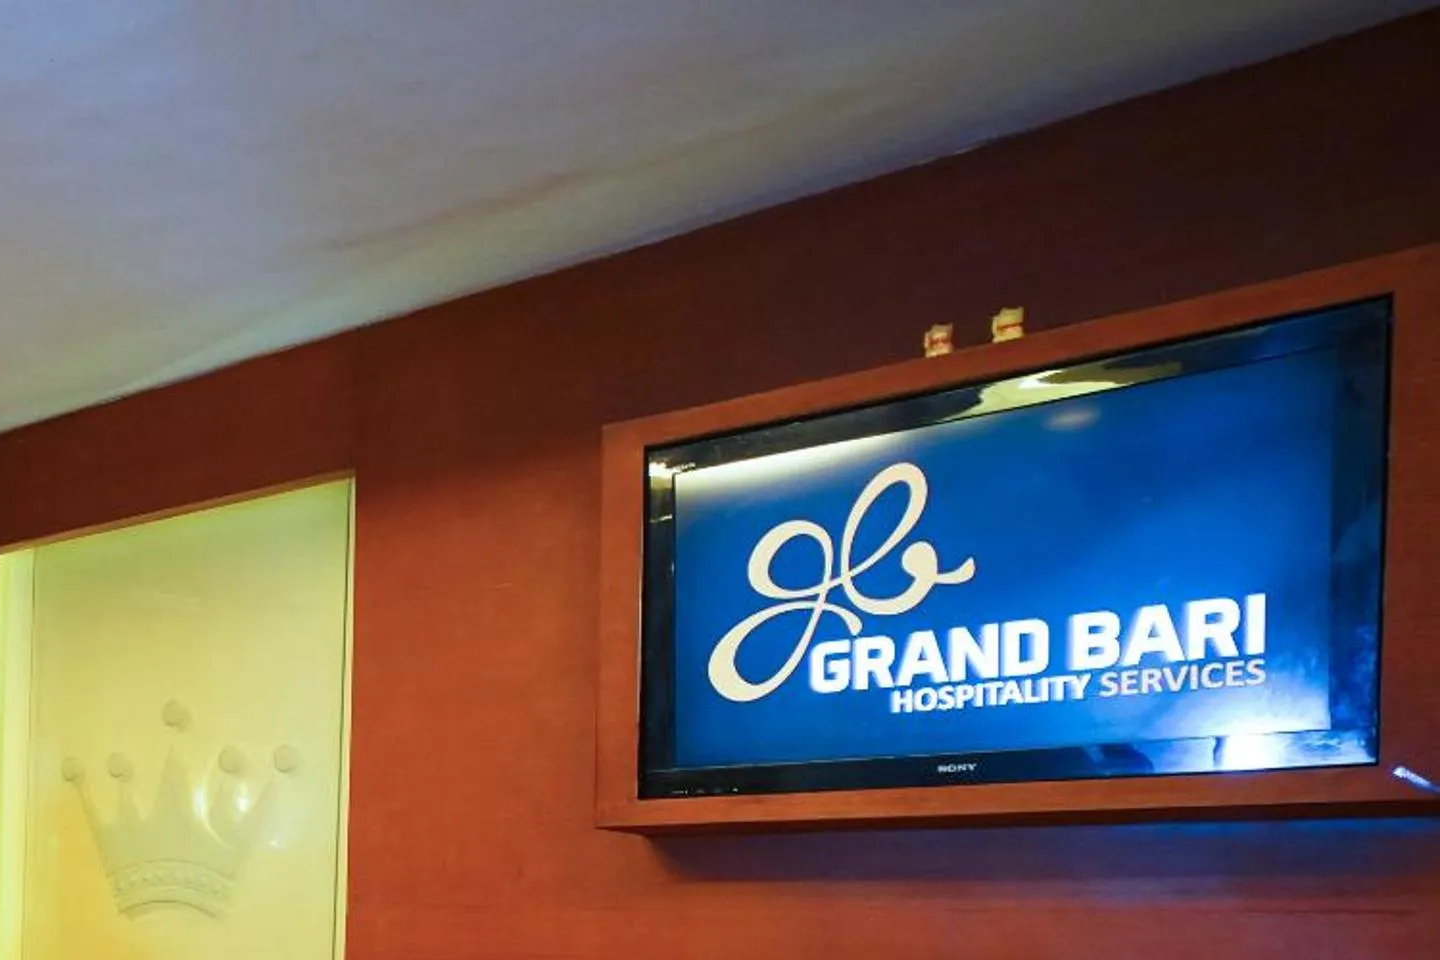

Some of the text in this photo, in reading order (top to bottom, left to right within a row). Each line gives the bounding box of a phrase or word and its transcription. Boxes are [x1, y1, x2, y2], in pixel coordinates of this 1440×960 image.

[810, 592, 1266, 694] GRAND BARI
[890, 657, 1266, 714] HOSPITALITY SERVICES
[937, 762, 977, 773] SONY
